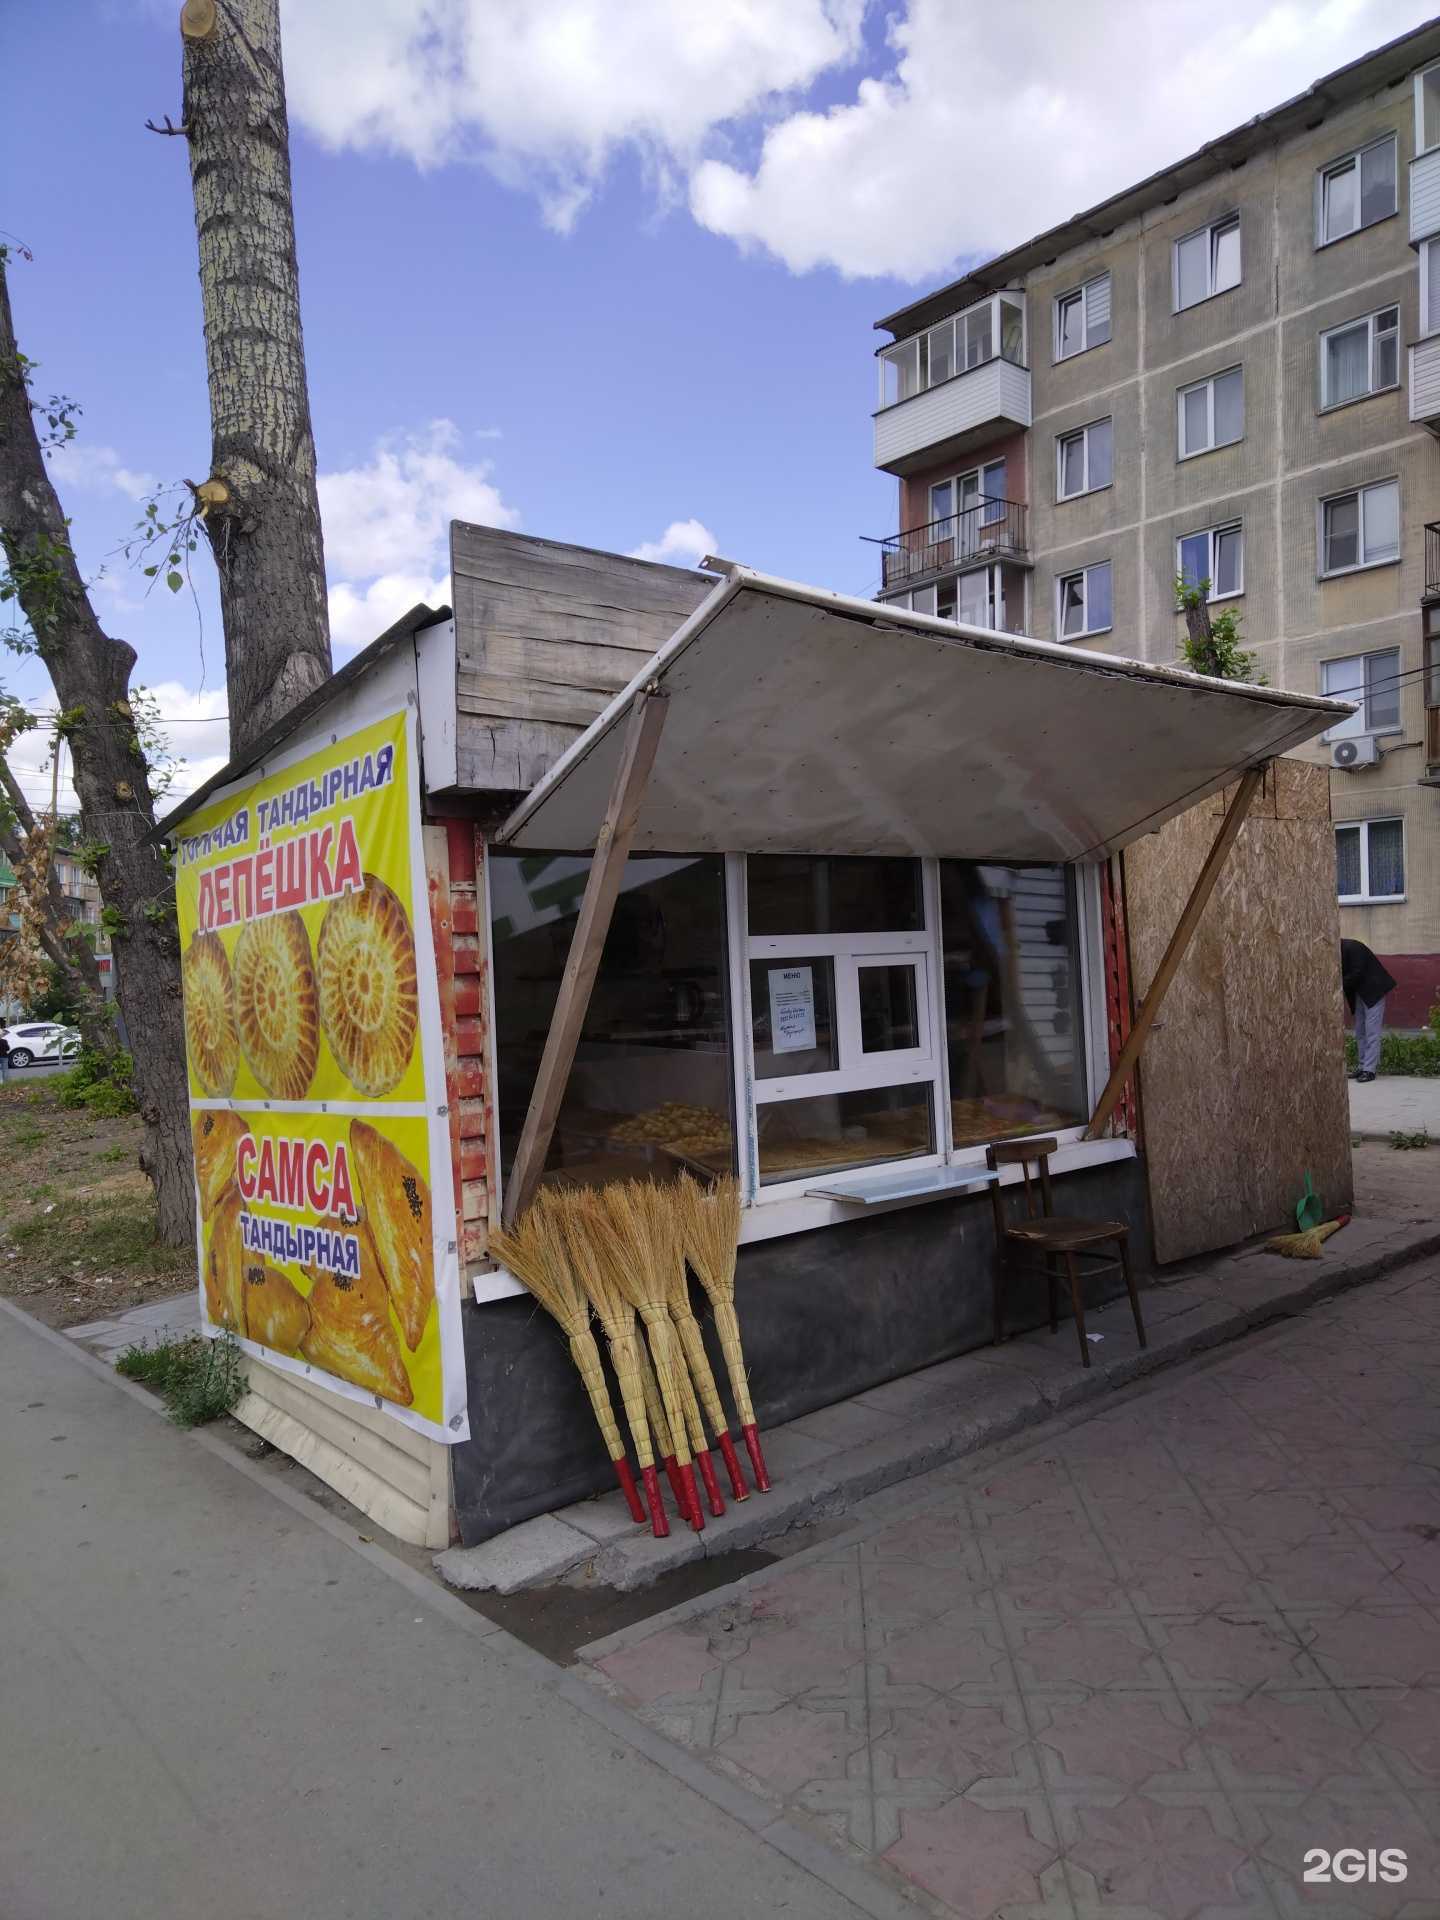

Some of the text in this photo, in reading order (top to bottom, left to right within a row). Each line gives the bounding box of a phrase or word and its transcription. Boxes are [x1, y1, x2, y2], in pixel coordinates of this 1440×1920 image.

[257, 744, 393, 834] ТАНДЫРНАЯ
[199, 820, 362, 930] ЛЕПЁШКА
[237, 1137, 356, 1218] САМСА
[240, 1214, 360, 1275] ТАНДЫРНАЯ
